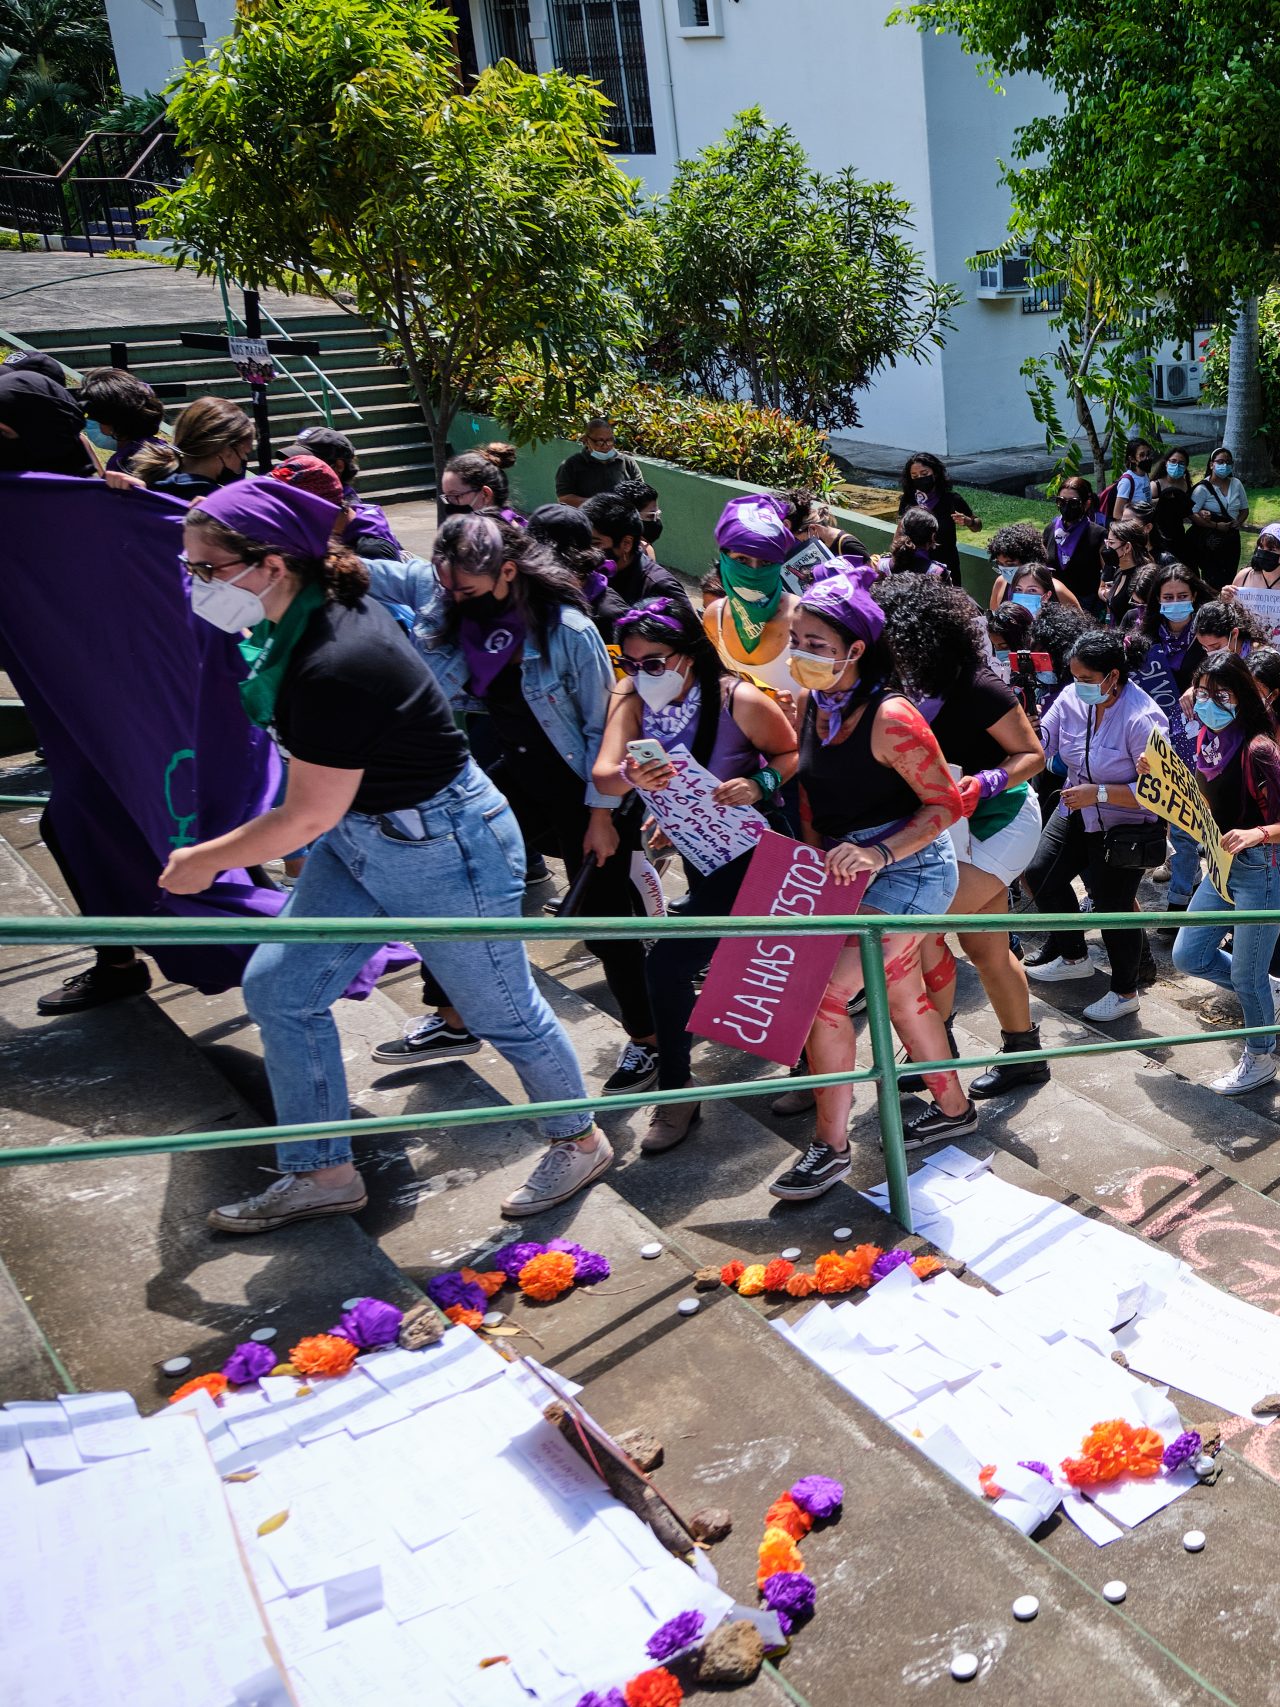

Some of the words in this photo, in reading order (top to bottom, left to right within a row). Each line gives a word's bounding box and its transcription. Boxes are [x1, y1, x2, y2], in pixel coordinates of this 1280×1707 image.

[670, 759, 707, 798] Ante
[1151, 730, 1168, 760] NO
[1170, 750, 1185, 776] ES
[666, 779, 731, 846] violencia
[663, 822, 718, 870] feminista
[684, 816, 732, 863] machista
[768, 845, 828, 918] ISTO?
[742, 939, 796, 993] HAS
[713, 990, 781, 1045] ¿LA
